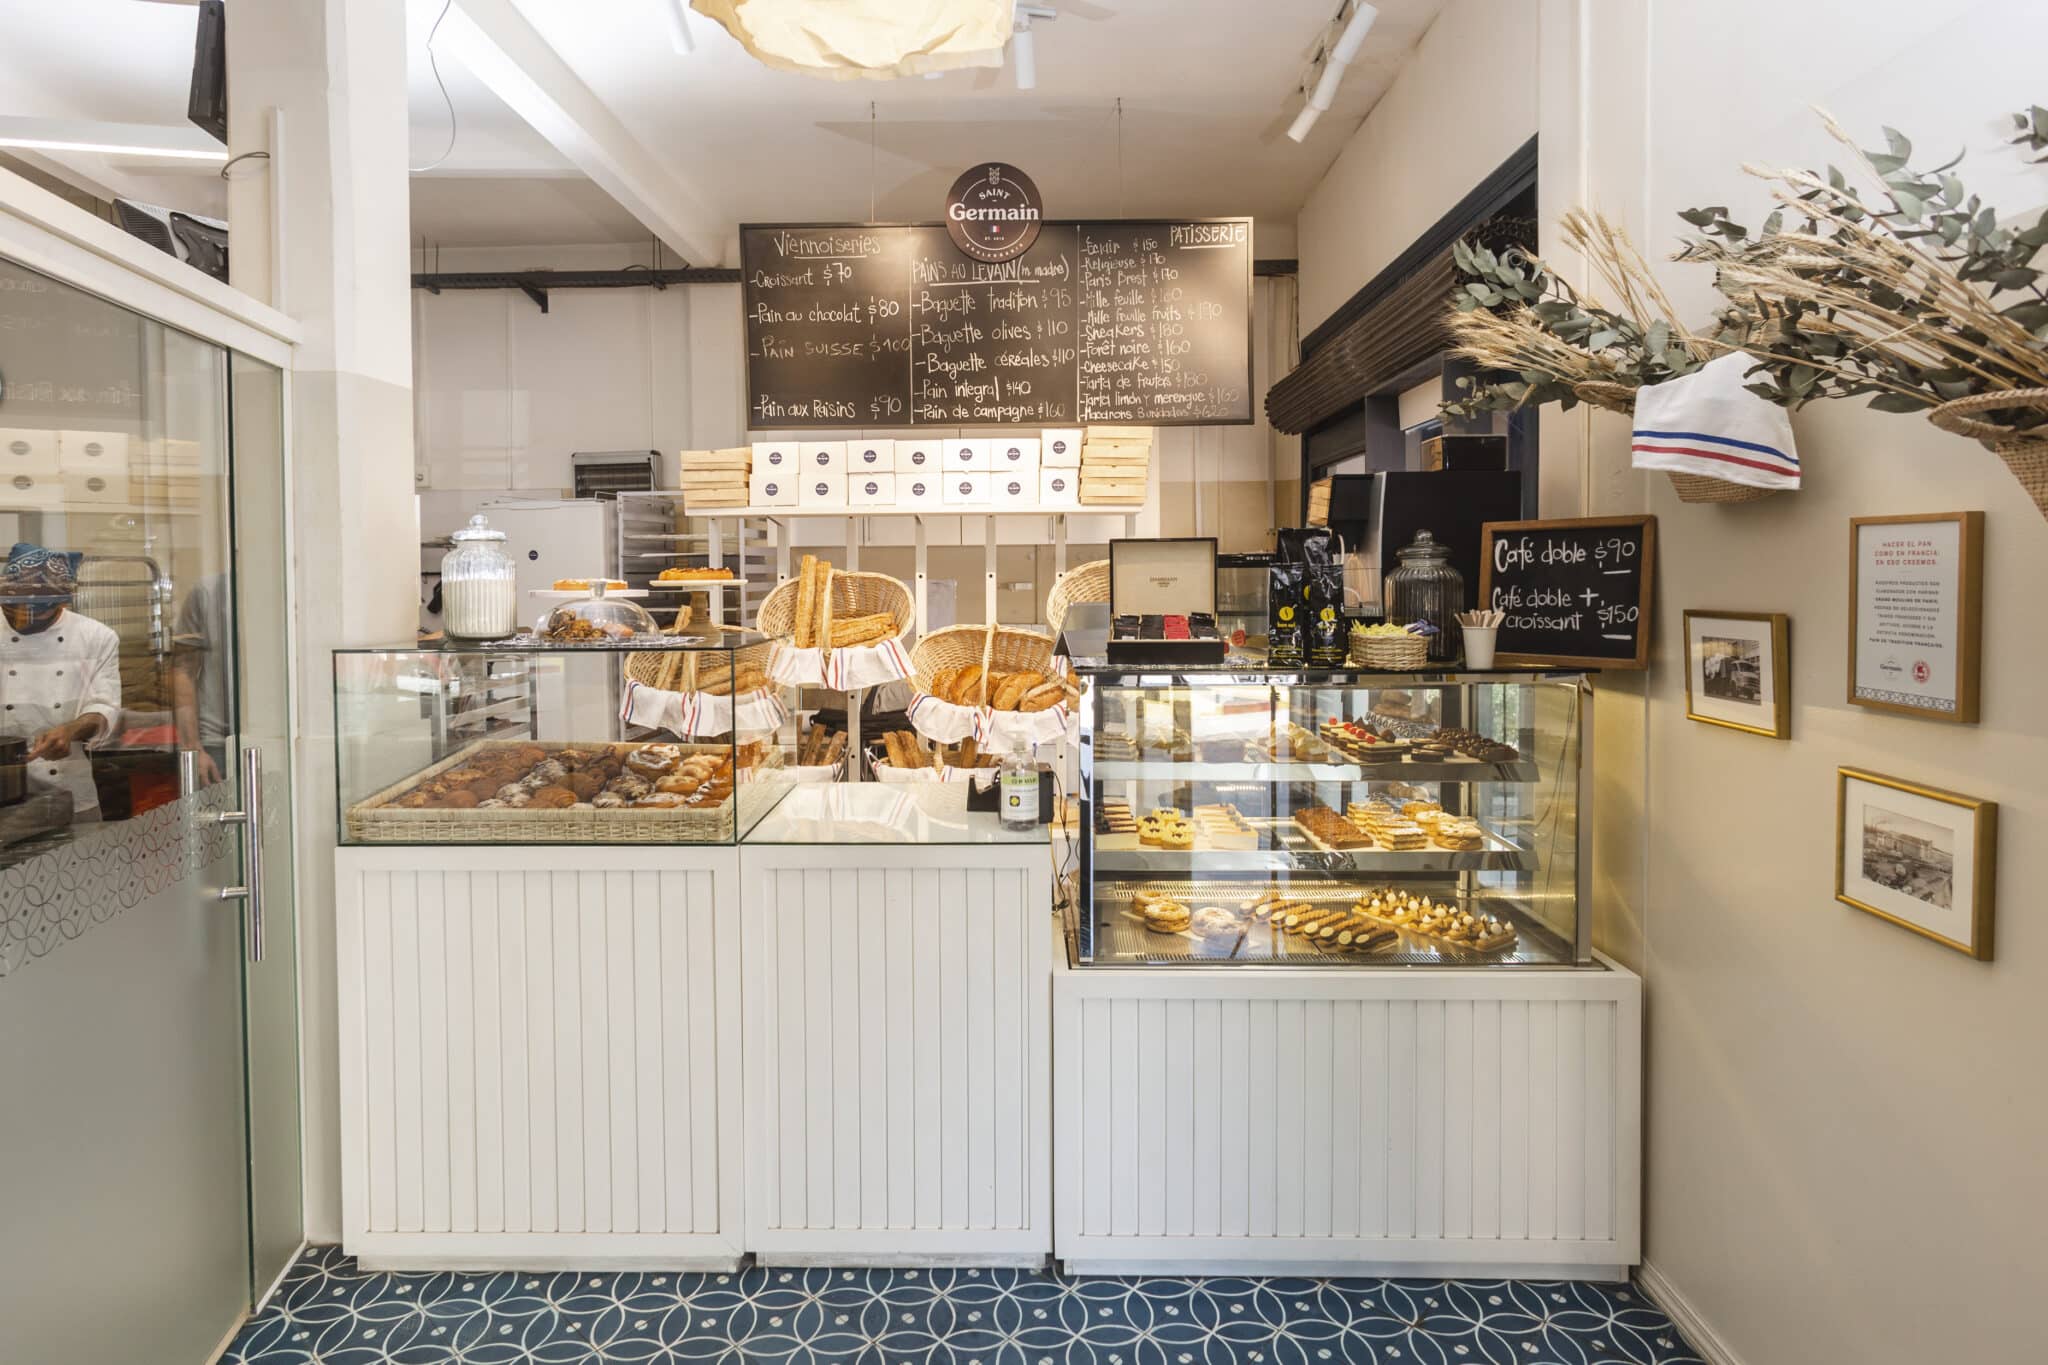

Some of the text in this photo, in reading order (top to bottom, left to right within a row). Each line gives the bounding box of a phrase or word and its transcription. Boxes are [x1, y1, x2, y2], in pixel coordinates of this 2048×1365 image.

[979, 188, 1010, 200] SAINT
[949, 203, 1039, 221] Germain
[774, 231, 881, 257] Viennoiseries
[1170, 224, 1245, 247] PATISSERIE
[823, 262, 852, 286] $70
[951, 263, 966, 280] AU
[972, 260, 1016, 281] LEVAIN
[1118, 267, 1148, 286] Brest
[1114, 289, 1144, 306] feuille
[786, 311, 802, 322] au
[809, 301, 862, 323] chocolat
[868, 296, 899, 324] $80
[1116, 307, 1146, 322] feuille
[1152, 305, 1182, 321] fruits
[991, 319, 1031, 340] olives
[804, 341, 864, 356] SUISSE
[869, 333, 911, 361] $100
[1120, 339, 1150, 355] noire
[954, 376, 999, 403] integral
[1116, 375, 1132, 390] de
[1137, 372, 1172, 389] frutas
[788, 405, 809, 417] aux
[814, 400, 856, 418] Raisins
[870, 396, 901, 420] $90
[1154, 392, 1205, 409] merengue
[952, 404, 969, 419] de
[973, 404, 1034, 422] campagne
[1494, 536, 1636, 573] Café doble $90
[1492, 584, 1523, 612] Café
[1527, 587, 1573, 609] doble
[1505, 600, 1639, 631] croissant $150
